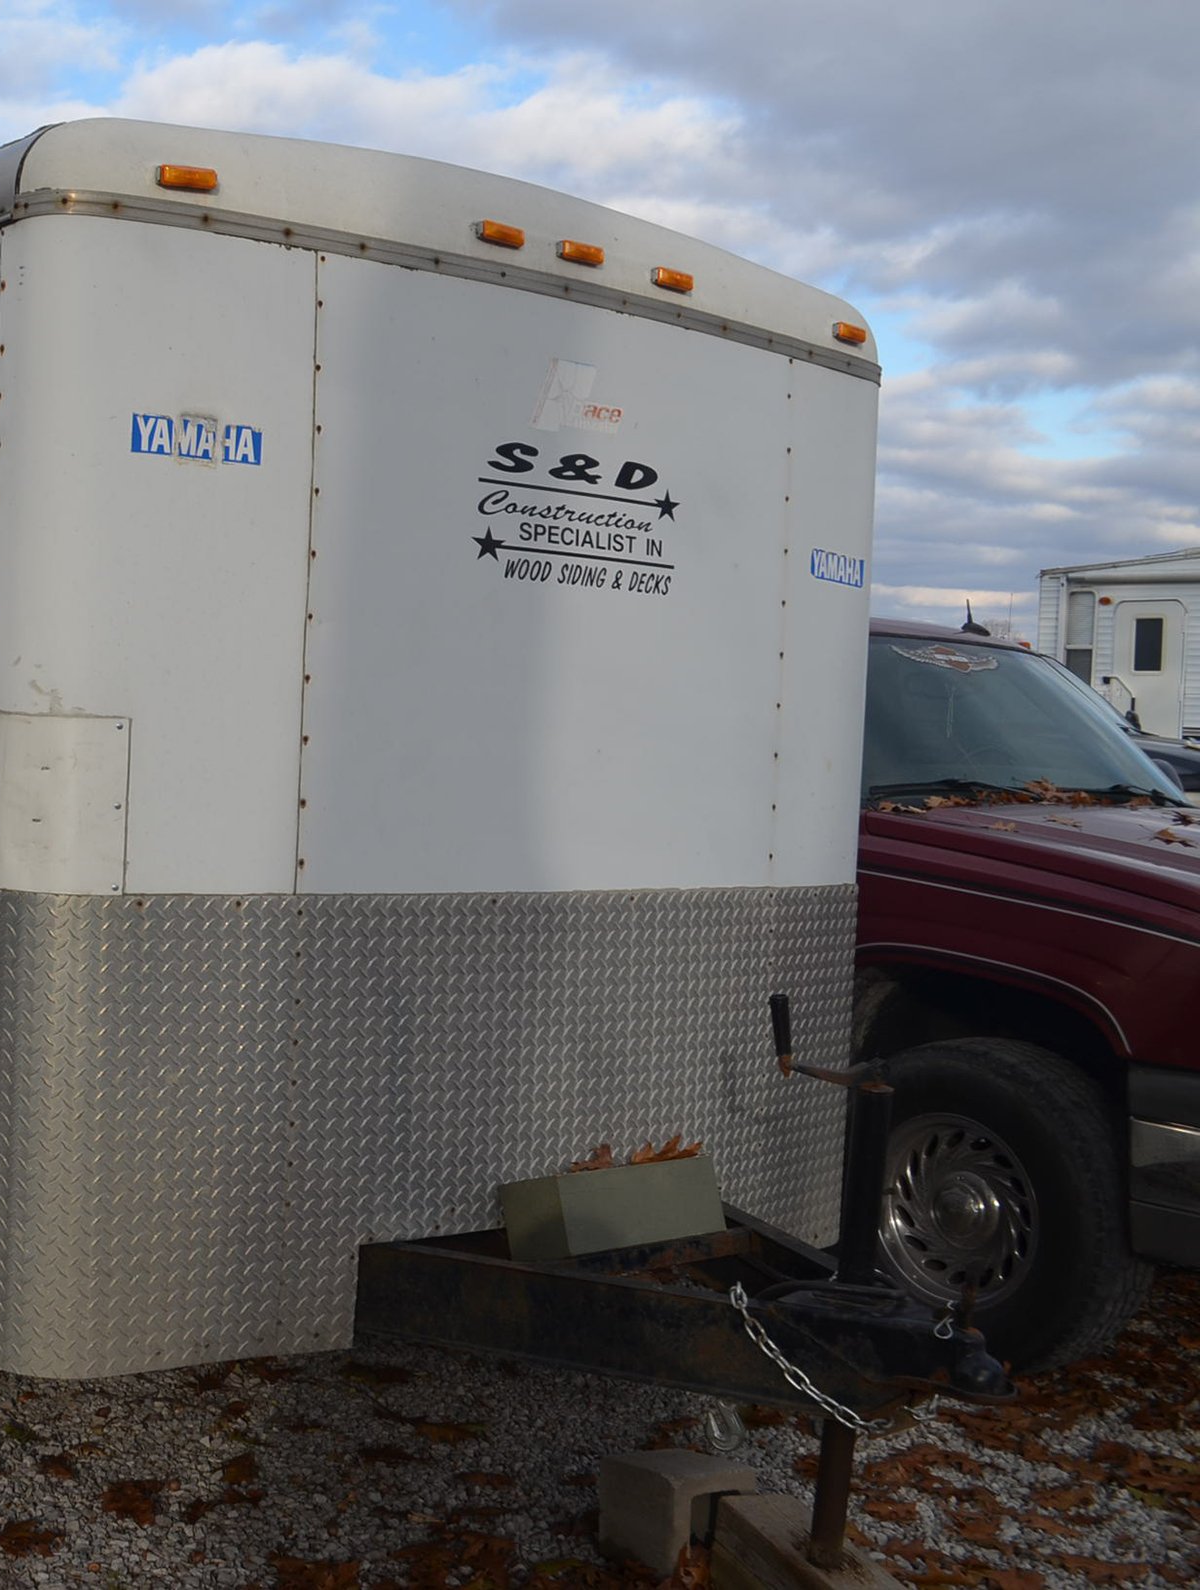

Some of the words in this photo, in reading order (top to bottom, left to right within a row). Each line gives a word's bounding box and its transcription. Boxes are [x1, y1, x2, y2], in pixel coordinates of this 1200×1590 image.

[134, 415, 259, 463] YAMAHA
[477, 489, 653, 533] Construction
[519, 522, 637, 554] SPECIALIST
[646, 538, 663, 558] IN
[504, 558, 552, 582] WOOD
[557, 563, 607, 588] SIDING
[611, 569, 623, 590] &
[628, 570, 672, 596] DECKS
[813, 548, 861, 587] YAMAHA
